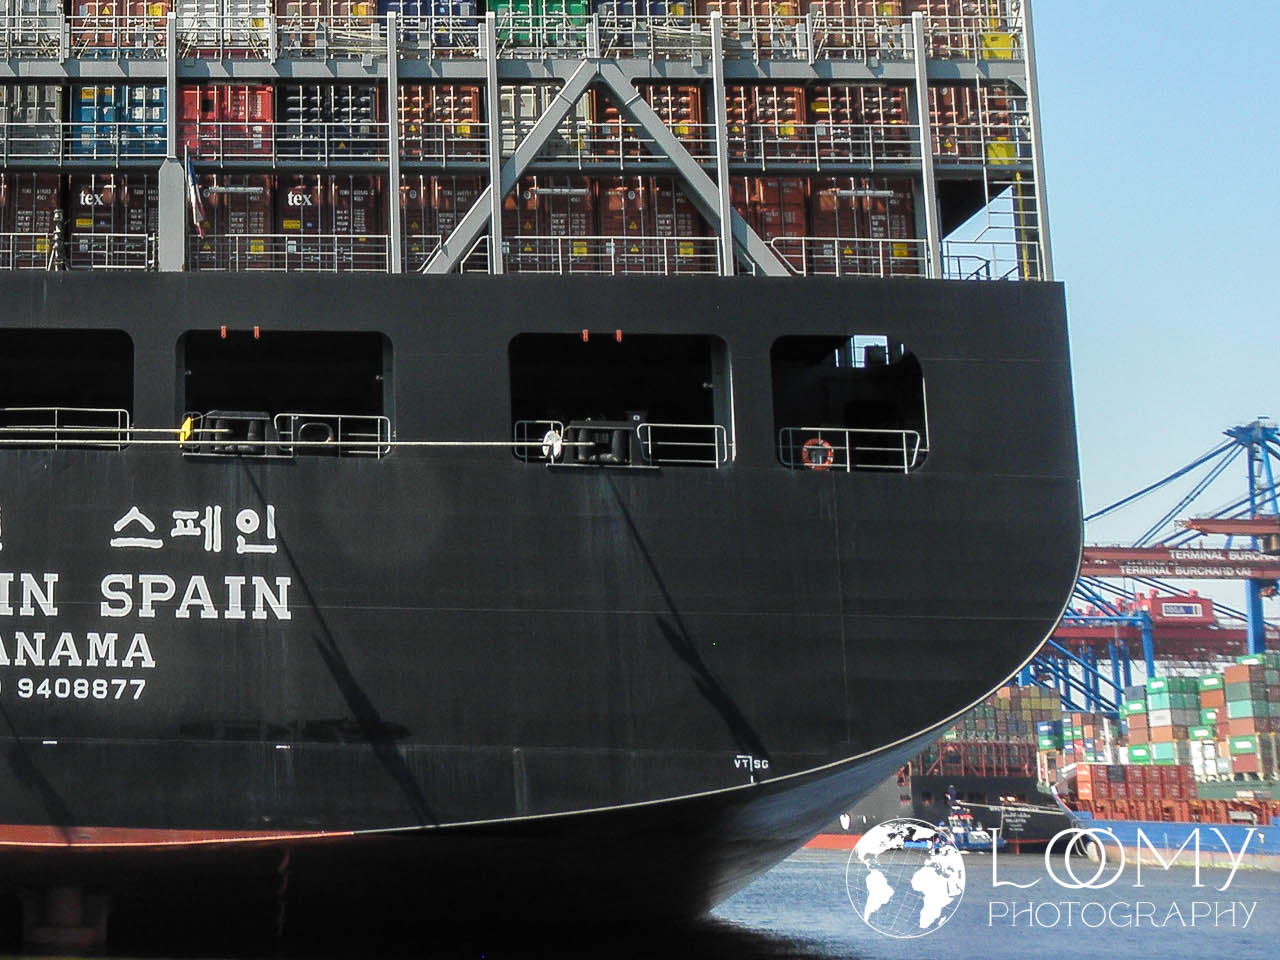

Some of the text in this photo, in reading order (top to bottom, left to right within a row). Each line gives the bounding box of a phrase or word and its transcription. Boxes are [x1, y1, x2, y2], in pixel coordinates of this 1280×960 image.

[79, 189, 103, 206] tex
[287, 191, 312, 206] tex
[110, 504, 278, 554] 스페인
[1170, 549, 1224, 561] TERMINAL
[1120, 565, 1172, 576] TERMINAL
[100, 573, 292, 620] SPAIN
[17, 677, 146, 700] 9408877
